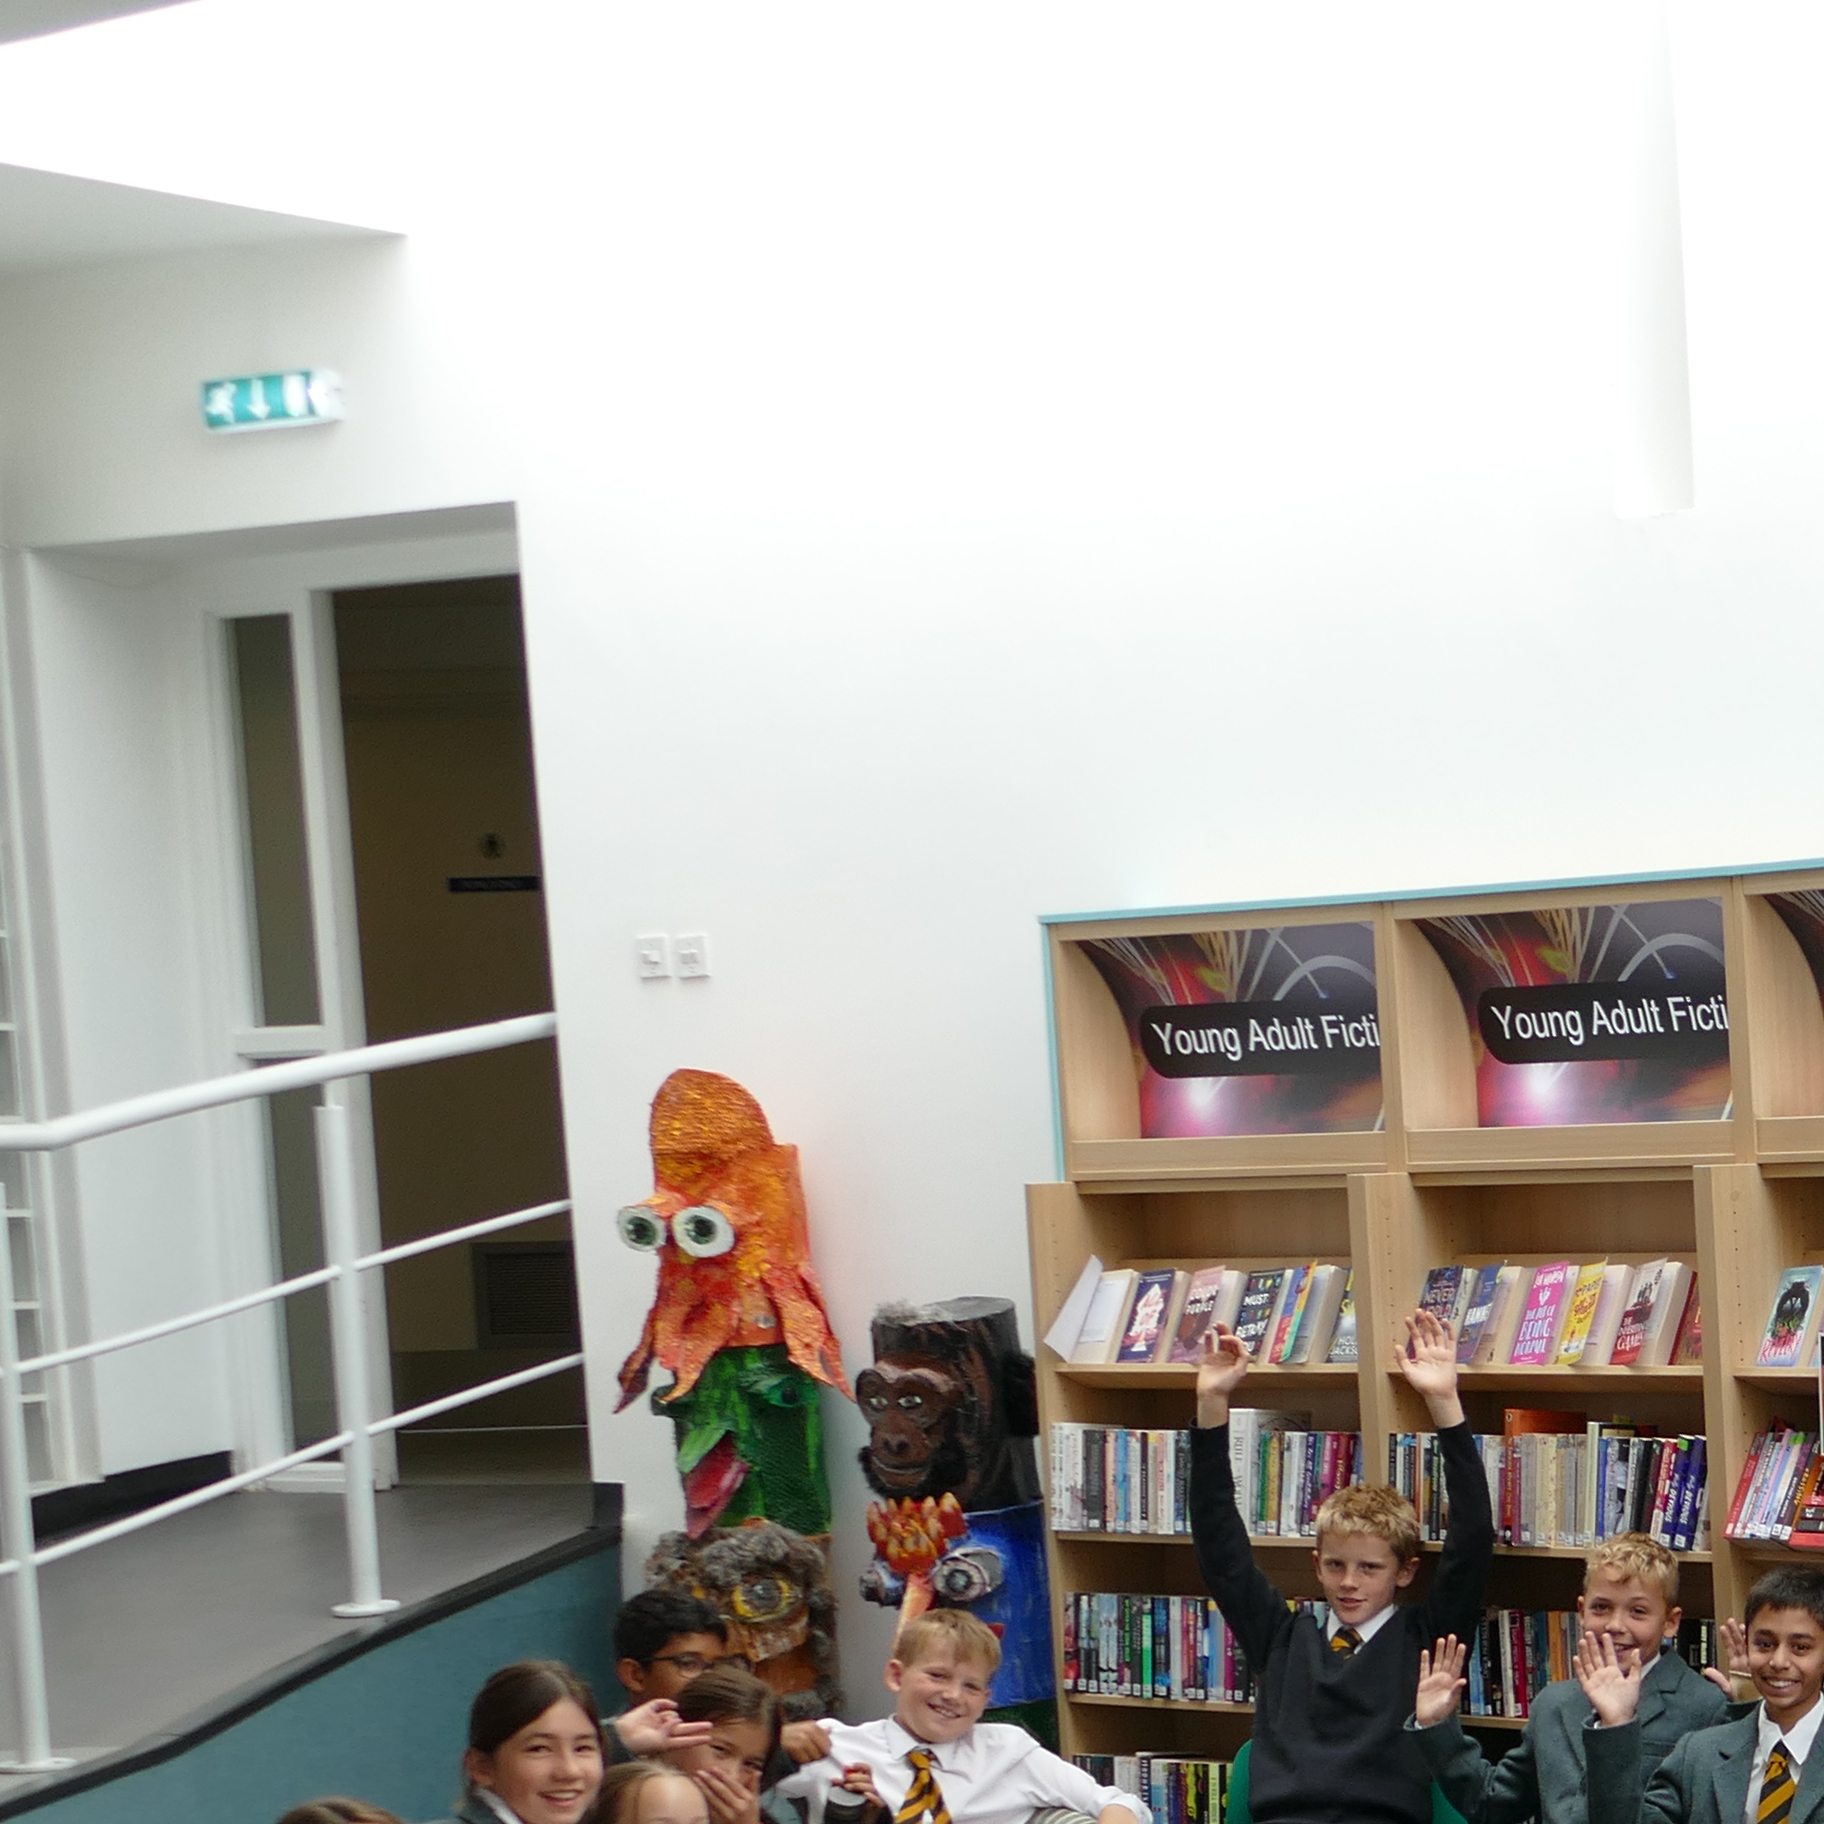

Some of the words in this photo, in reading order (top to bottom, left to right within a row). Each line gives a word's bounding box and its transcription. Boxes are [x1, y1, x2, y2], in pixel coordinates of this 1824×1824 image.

[1151, 1022, 1242, 1061] Young
[1249, 1016, 1318, 1052] Adult
[1319, 1013, 1380, 1048] Ficti
[1491, 1005, 1585, 1045] Young
[1592, 998, 1665, 1036] Adult
[1666, 995, 1729, 1032] Ficti
[1244, 1294, 1270, 1306] MUST
[1521, 1317, 1552, 1340] BEING
